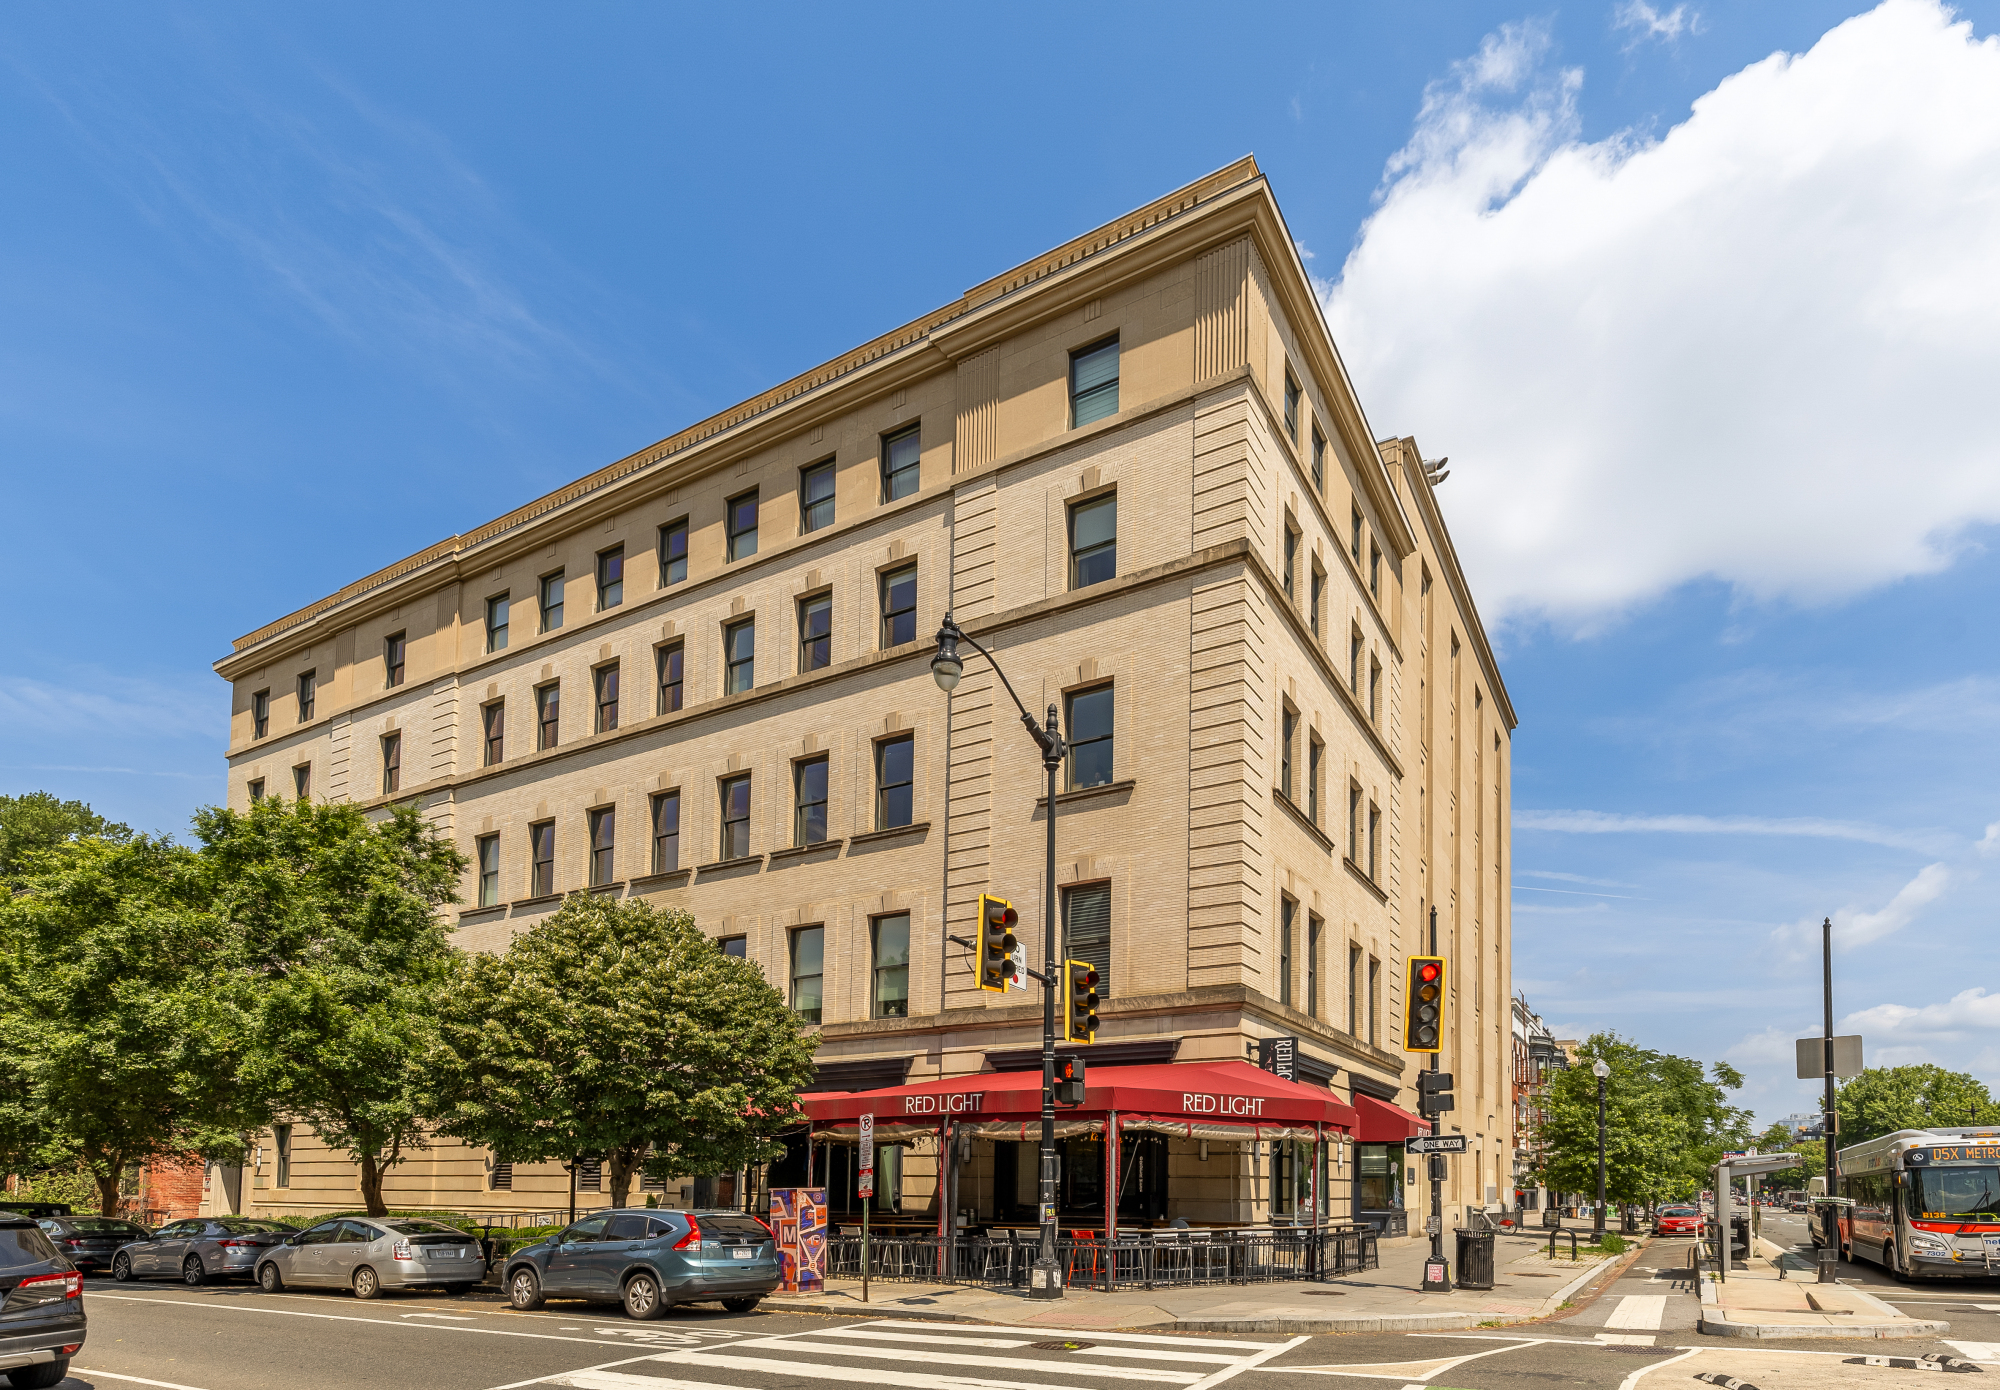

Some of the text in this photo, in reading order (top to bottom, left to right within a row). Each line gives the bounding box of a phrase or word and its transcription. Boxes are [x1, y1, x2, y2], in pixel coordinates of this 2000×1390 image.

[1011, 953, 1022, 964] URN
[1275, 1039, 1293, 1061] RED
[905, 1093, 983, 1114] RED LIGHT
[1183, 1093, 1265, 1116] RED LIGHT
[1423, 1139, 1460, 1148] ONE WAY
[1933, 1147, 1959, 1160] D5X
[1922, 1211, 1946, 1219] B136
[783, 1225, 796, 1243] M
